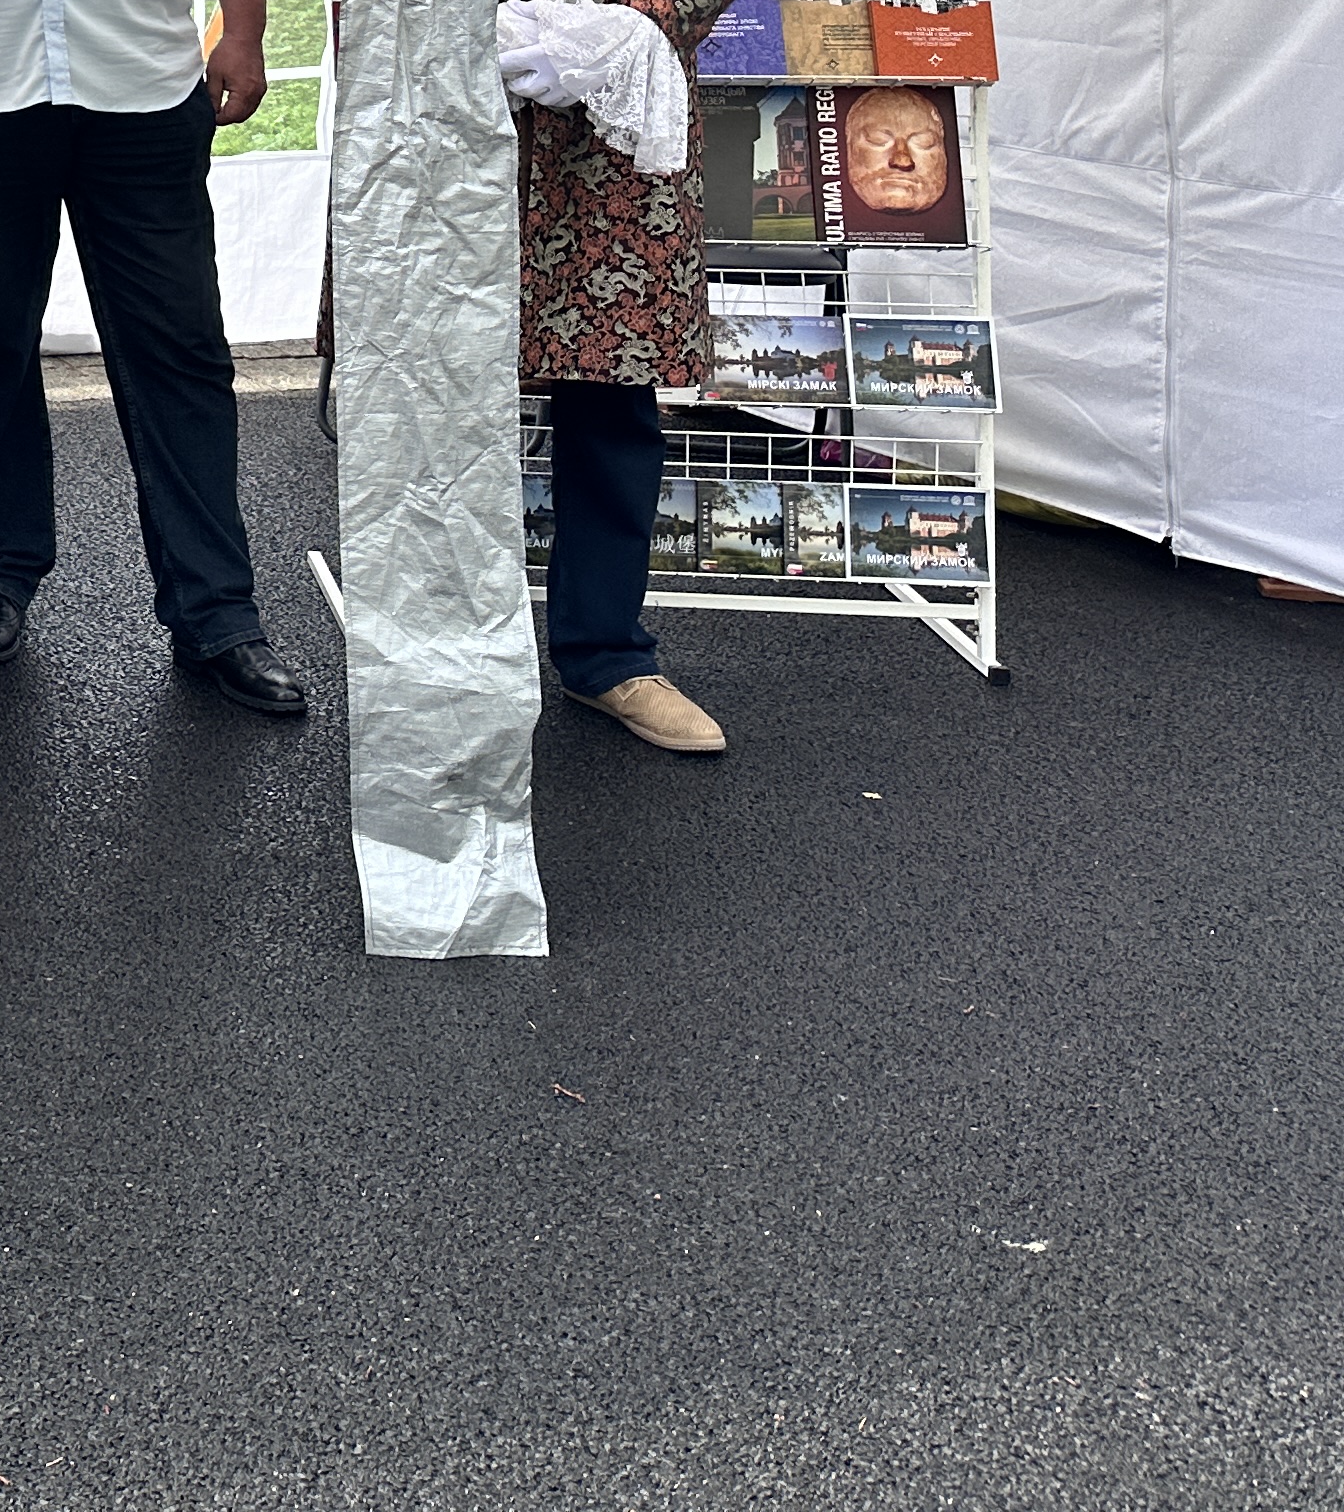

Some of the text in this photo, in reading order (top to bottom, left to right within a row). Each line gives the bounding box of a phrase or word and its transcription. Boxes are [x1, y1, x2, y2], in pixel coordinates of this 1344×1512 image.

[815, 85, 846, 242] ULTIMA RATIO REG
[747, 379, 837, 391] МІРСКІ ЗАМАК
[870, 381, 982, 396] МИРСКИЙ ЗАМОК
[650, 533, 697, 554] 城堡
[866, 553, 976, 568] МИРСКИЙ ЗАМОК
